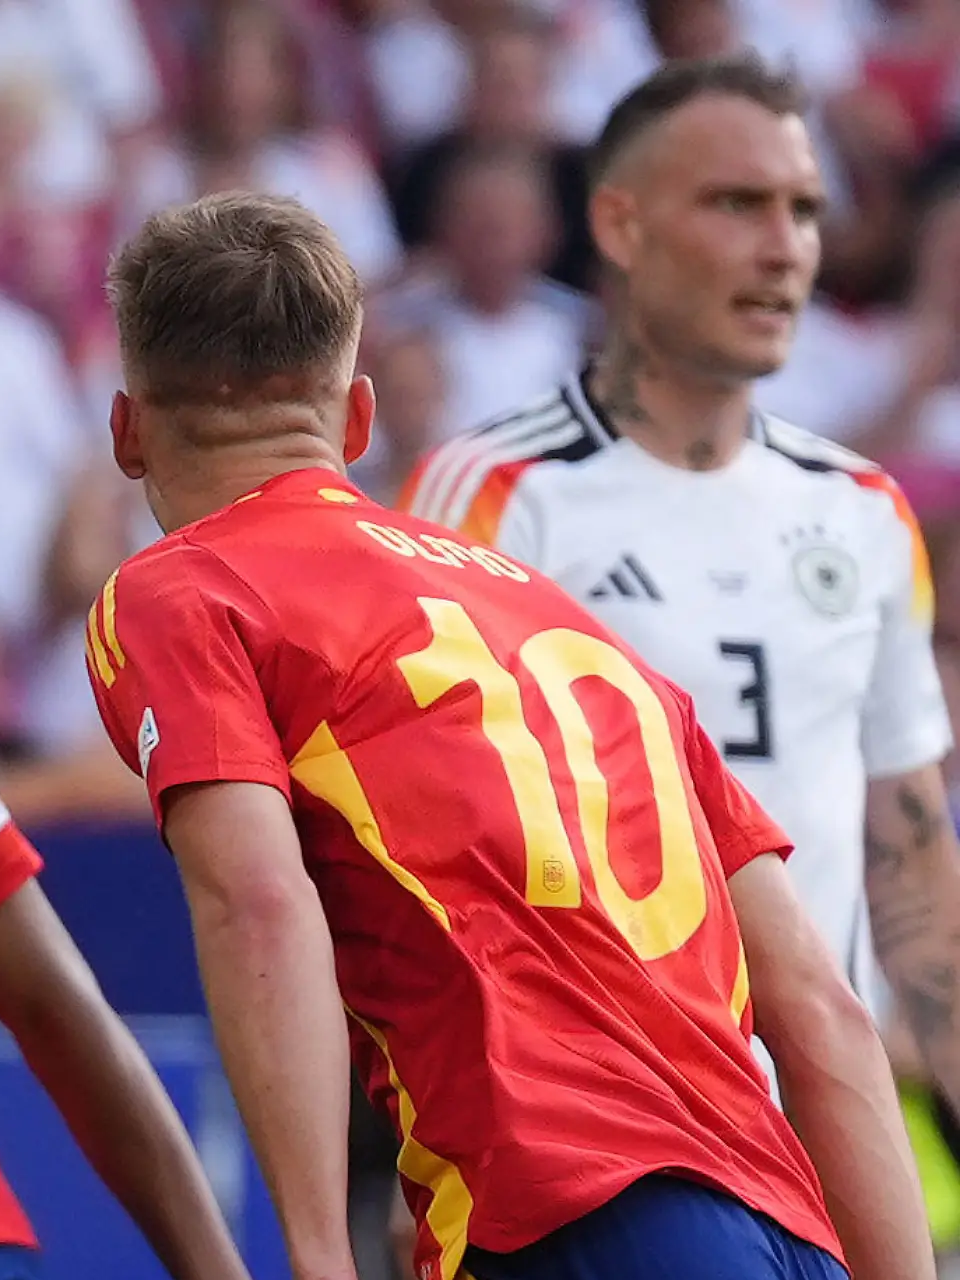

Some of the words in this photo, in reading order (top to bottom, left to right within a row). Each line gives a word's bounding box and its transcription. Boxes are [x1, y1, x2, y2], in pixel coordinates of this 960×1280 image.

[356, 520, 531, 583] OLMO
[719, 641, 772, 759] 3
[395, 596, 707, 962] 10
